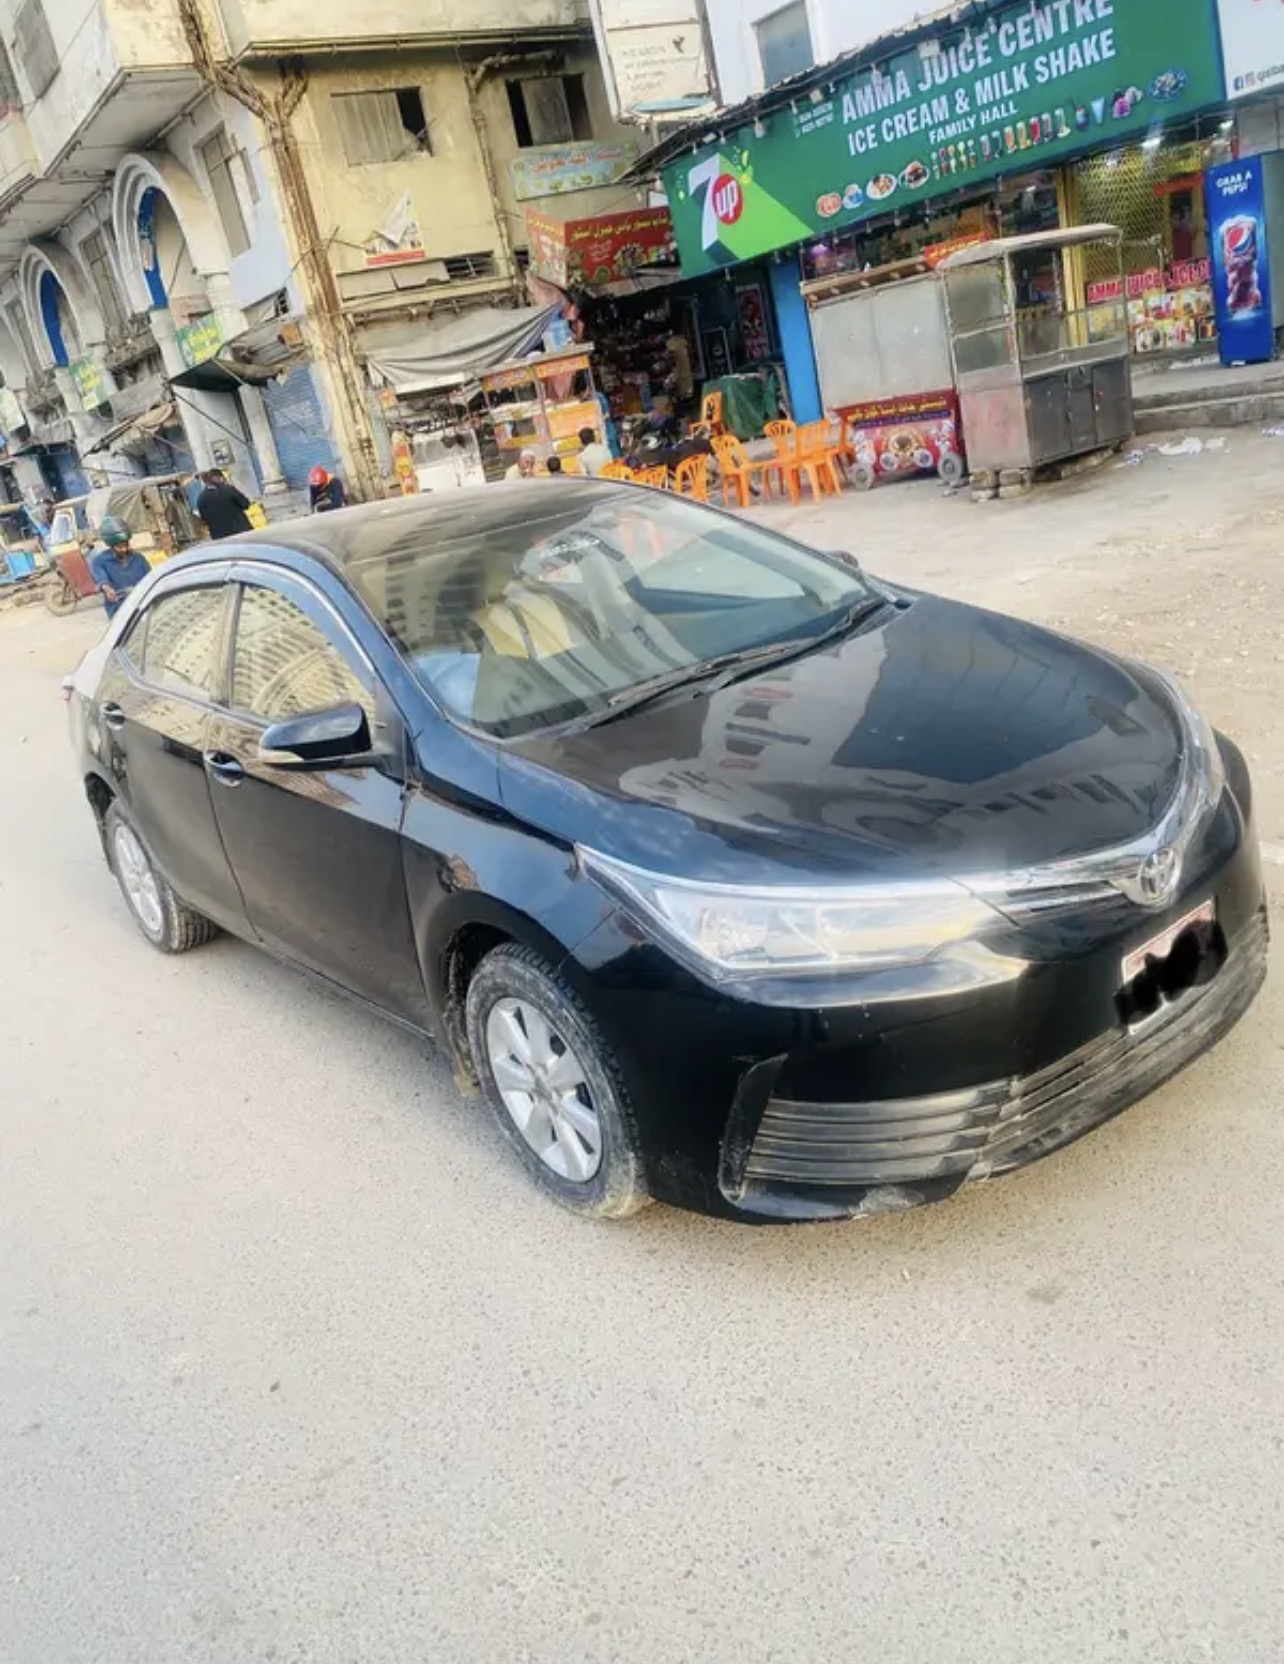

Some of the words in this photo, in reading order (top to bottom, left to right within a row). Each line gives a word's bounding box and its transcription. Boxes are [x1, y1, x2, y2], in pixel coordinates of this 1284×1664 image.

[842, 69, 911, 124] AMMA
[918, 33, 993, 92] JUICE
[848, 130, 879, 157] ICE
[881, 94, 949, 147] CREAM
[954, 88, 970, 115] &
[975, 62, 1030, 107] MILK
[1034, 28, 1116, 84] SHAKE
[928, 115, 977, 145] FAMILY
[981, 101, 1019, 126] HALL
